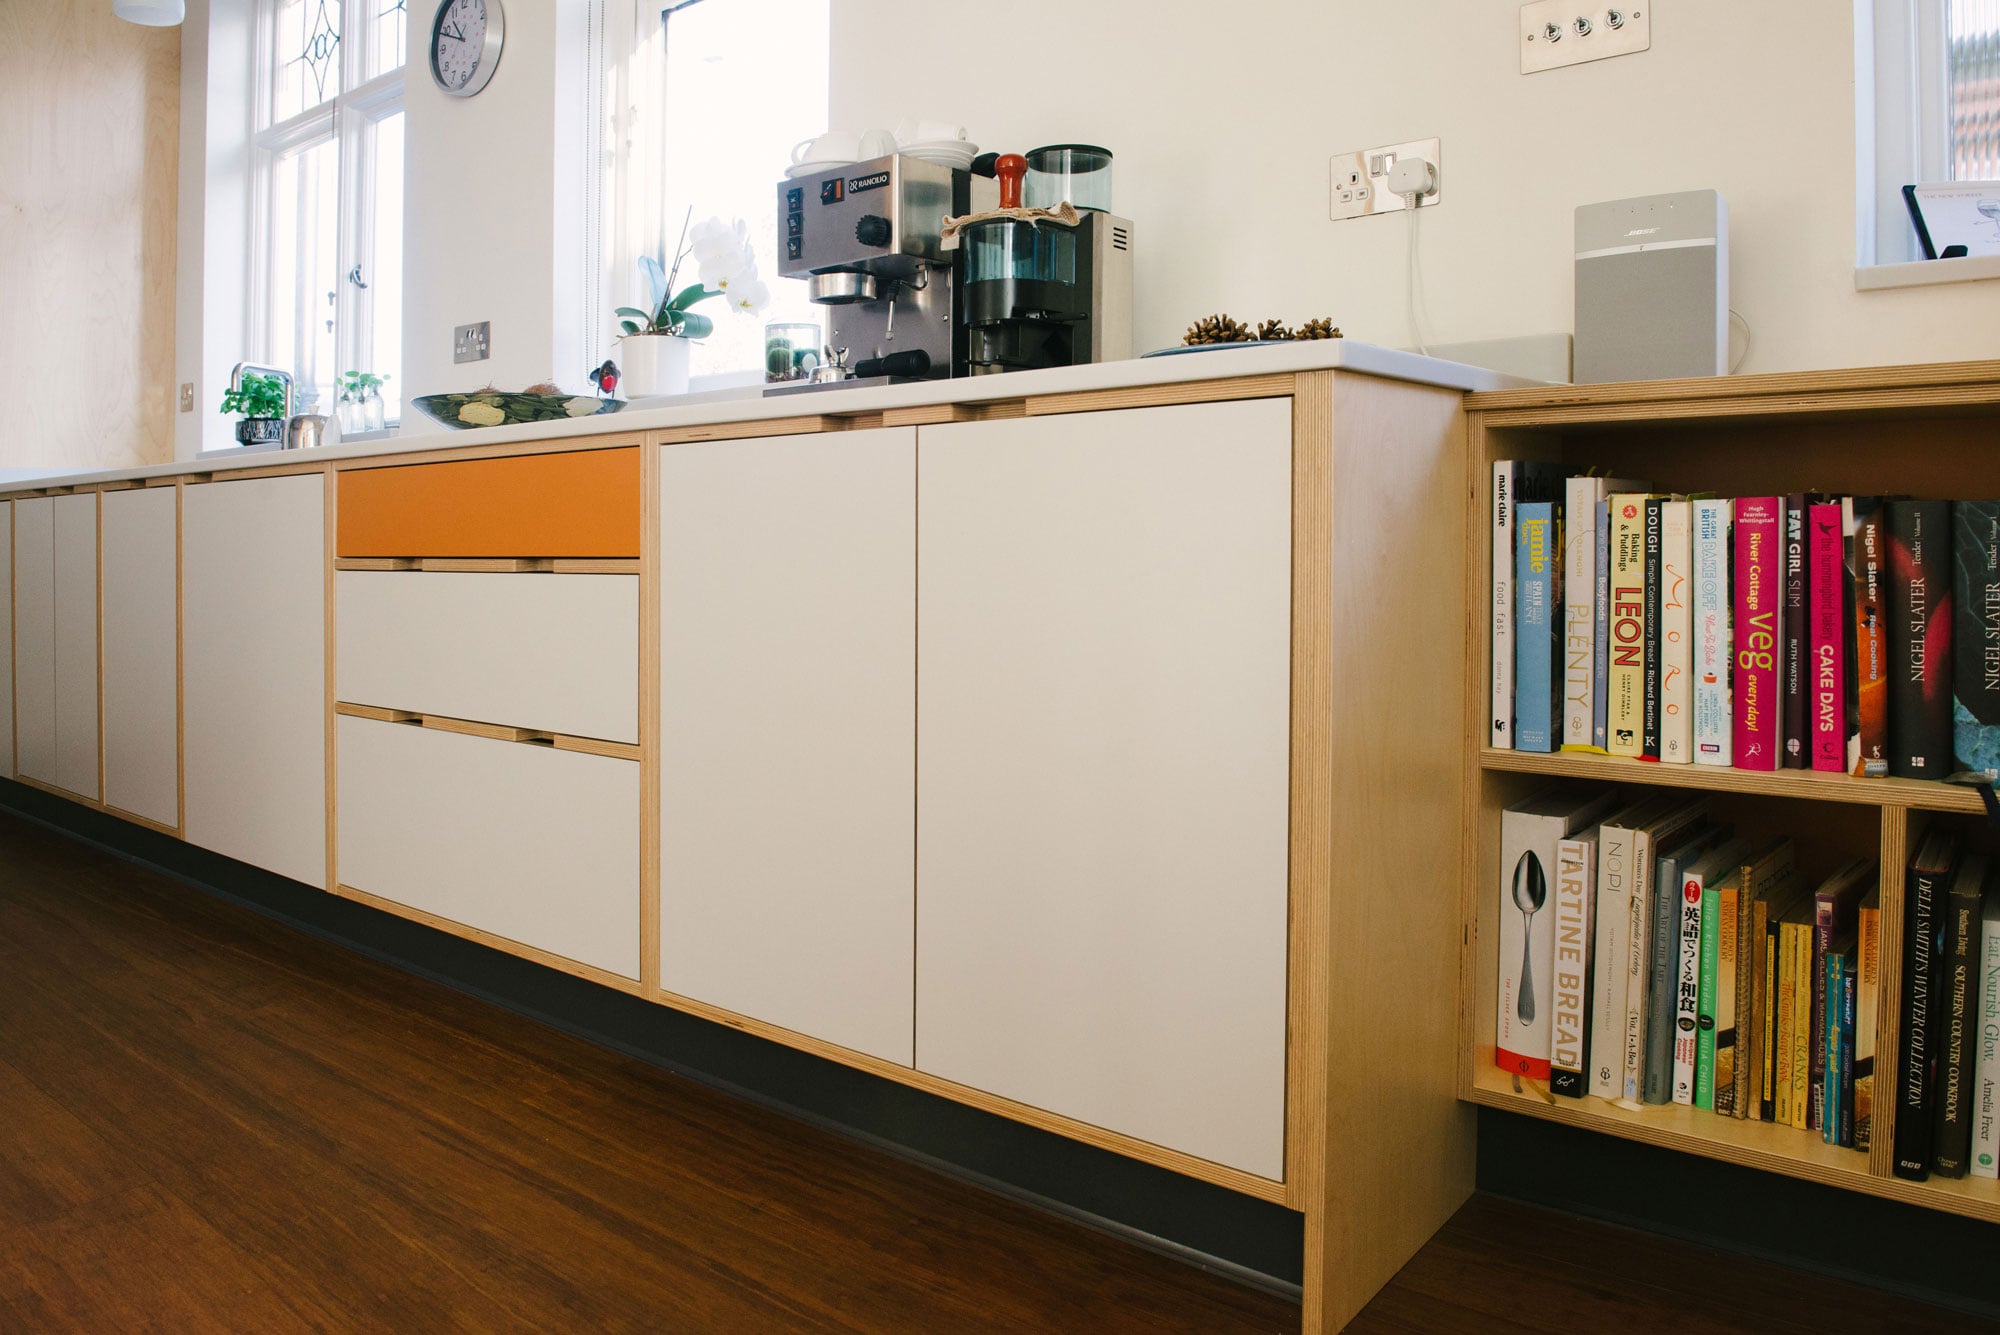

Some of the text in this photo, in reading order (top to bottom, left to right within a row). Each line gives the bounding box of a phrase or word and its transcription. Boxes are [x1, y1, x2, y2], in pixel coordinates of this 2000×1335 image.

[451, 7, 458, 19] 11
[440, 44, 446, 55] 9
[444, 61, 449, 72] 8
[451, 70, 456, 81] 7
[461, 70, 467, 81] 6
[858, 175, 888, 188] RANCILIO
[1623, 227, 1661, 237] BOSE
[1498, 474, 1508, 528] marie claire
[1701, 508, 1710, 540] BRITISH
[1521, 522, 1531, 545] does
[1526, 518, 1549, 574] jamie
[1617, 523, 1629, 573] & Puddings
[1629, 533, 1641, 563] Baking
[1788, 509, 1802, 608] FAT GIRL SLIM
[1912, 541, 1922, 566] Tender
[1987, 543, 1997, 571] Tender
[1701, 541, 1717, 611] BAKE OFF
[1746, 532, 1761, 610] River Cottage
[1865, 524, 1877, 602] Nigel Slater
[1496, 581, 1506, 636] food fast
[1533, 580, 1543, 606] SPAIN
[1597, 576, 1607, 621] Bodyfoods
[1646, 506, 1658, 731] DOUGH Simple Contemporary Bread Richard Bertinet
[1614, 587, 1642, 667] LEON
[1739, 611, 1774, 672] Veg
[1869, 614, 1878, 680] Real Cooking
[1911, 577, 1925, 682] NIGEL SLATER
[1985, 582, 2000, 690] NIGEL SLATER
[1567, 604, 1590, 708] PLENTY
[1790, 638, 1798, 695] RUTH WATSON
[1745, 674, 1760, 731] everyday!
[1820, 645, 1834, 732] CAKE DAYS
[1607, 841, 1623, 893] NOPI
[1559, 843, 1585, 963] TARTINE
[1660, 915, 1669, 930] ART
[1959, 908, 1970, 935] Southern
[1656, 962, 1667, 984] TART
[1679, 906, 1701, 1014] 英語でつくる和食
[1703, 897, 1713, 1011] Julia's Kitchen Wisdom
[1555, 972, 1580, 1063] BREAD
[1780, 997, 1793, 1024] Cranks
[1908, 878, 1932, 1110] DELIA SMITH'S WINTER COLLECTION
[1983, 935, 2000, 1062] Eat. Nourish. Glow.
[1699, 1034, 1709, 1093] JULIA CHILD
[1780, 1028, 1791, 1057] Recipe
[1796, 1035, 1809, 1091] CRANKS
[1945, 964, 1967, 1123] SOUTHERN COUNTRY COOKBOOK
[1779, 1058, 1789, 1084] Book
[1980, 1078, 1995, 1142] Amelia Freer
